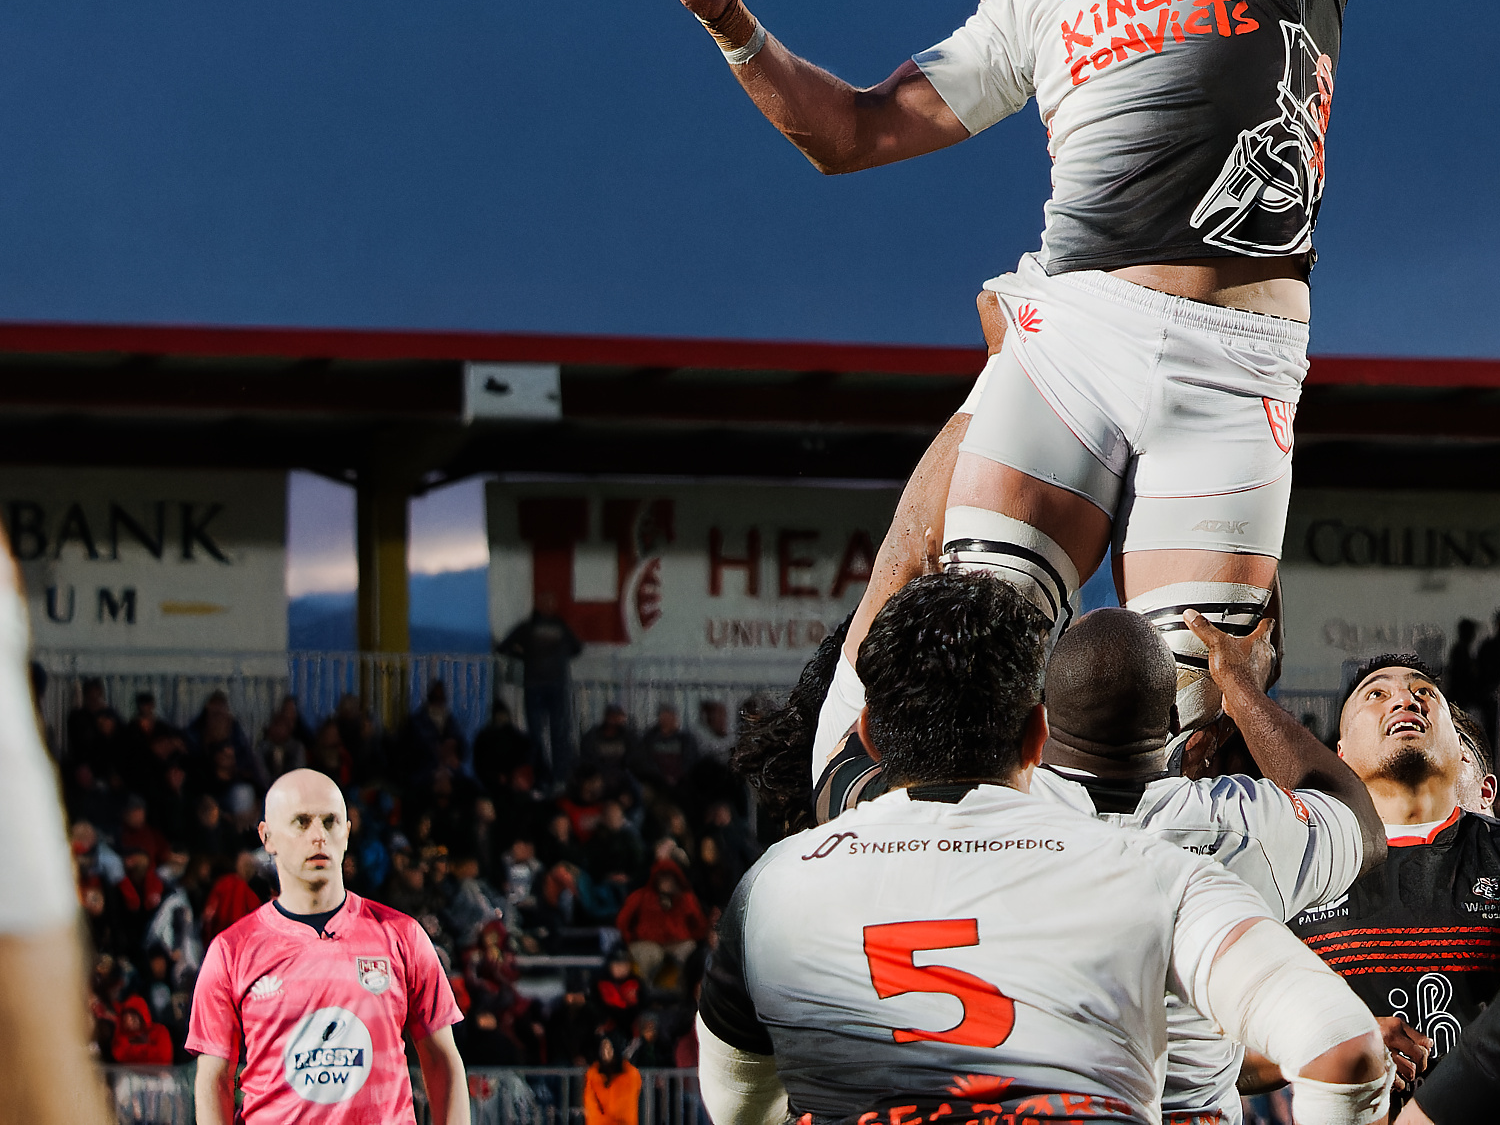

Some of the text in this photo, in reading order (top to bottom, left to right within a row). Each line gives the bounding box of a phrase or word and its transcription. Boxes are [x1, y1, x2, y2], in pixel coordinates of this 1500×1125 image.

[7, 498, 232, 565] BANK
[1303, 518, 1500, 567] COLLINS
[708, 526, 875, 597] HEA
[848, 839, 1066, 855] SYNERGY ORTHOPEDICS
[1298, 907, 1349, 926] PALADIN
[863, 918, 1016, 1049] 5
[295, 1049, 360, 1070] RUGBY
[304, 1070, 350, 1086] NOW
